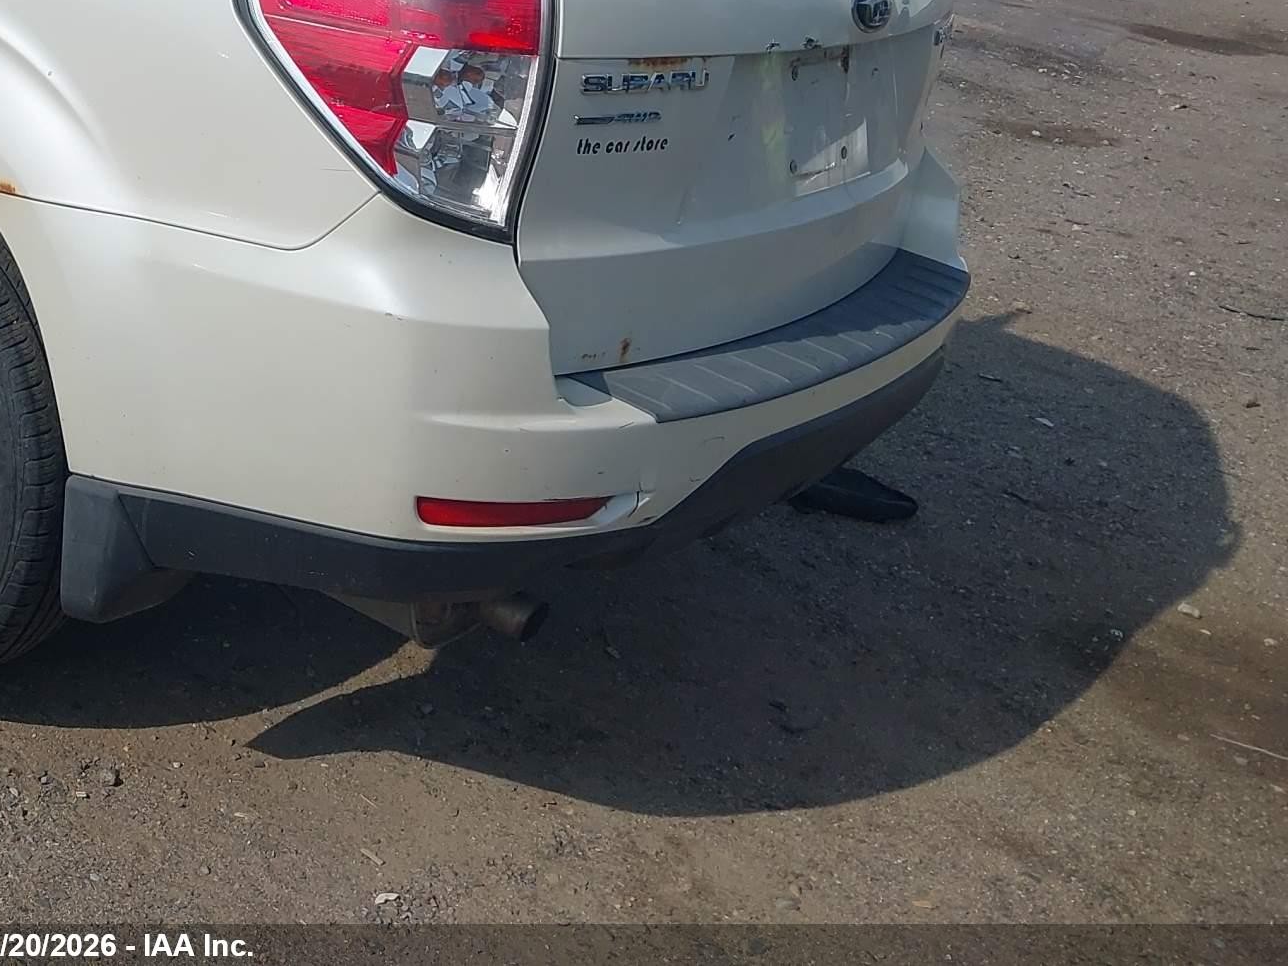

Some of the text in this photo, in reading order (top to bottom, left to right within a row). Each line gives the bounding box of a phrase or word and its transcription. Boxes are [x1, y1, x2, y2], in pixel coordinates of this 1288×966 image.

[581, 70, 710, 94] SUBARU
[576, 136, 669, 155] the car store
